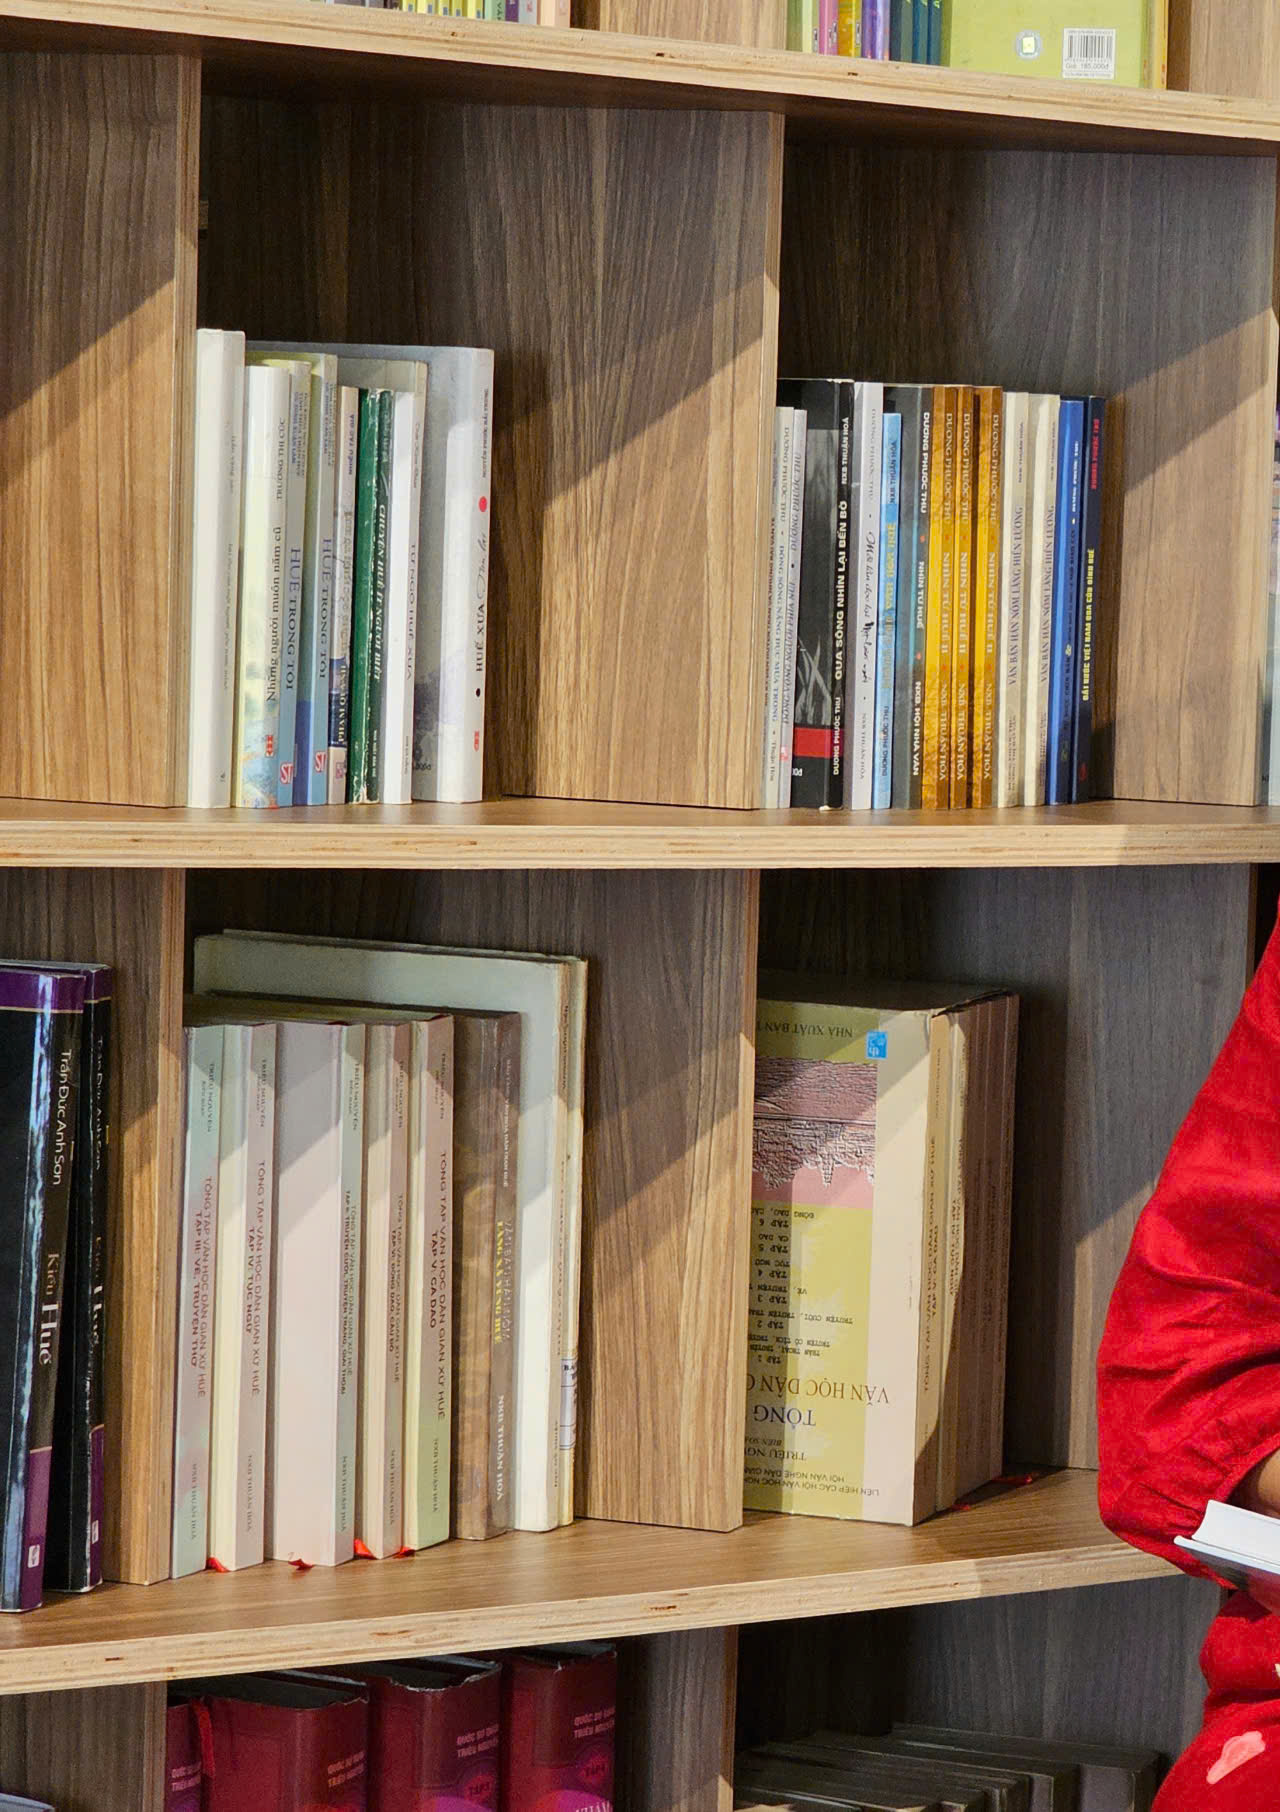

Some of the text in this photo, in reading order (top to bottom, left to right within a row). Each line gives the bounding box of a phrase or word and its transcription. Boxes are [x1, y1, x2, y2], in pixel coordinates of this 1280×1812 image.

[922, 412, 930, 451] DƯƠNG
[920, 452, 930, 489] PHƯỚC
[920, 492, 928, 514] THU
[272, 526, 282, 542] cũ
[272, 546, 281, 572] năm
[917, 561, 925, 588] NHÌN
[270, 577, 280, 612] muôn
[834, 500, 848, 680] QUA SÔNG NHÌN LẠI BẾN BỜ
[270, 618, 280, 654] người
[912, 707, 921, 726] HỘI
[828, 1024, 853, 1038] NHÀ
[53, 1048, 72, 1184] Trần Đức Anh Sơn
[769, 1219, 789, 1228] TẬP
[758, 1234, 789, 1242] CA DAO
[769, 1243, 788, 1254] TẬP
[768, 1269, 788, 1279] TẬP
[430, 1276, 437, 1295] CA
[768, 1294, 788, 1304] TẬP
[429, 1298, 437, 1328] DAO
[253, 1314, 262, 1345] GIAN
[767, 1319, 784, 1330] TẬP
[438, 1328, 447, 1362] GIAN
[760, 1376, 800, 1398] DÂN
[805, 1378, 845, 1399] HỌC
[850, 1384, 889, 1406] VĂN
[753, 1404, 816, 1430] TỔNG
[819, 1484, 836, 1493] CÁC
